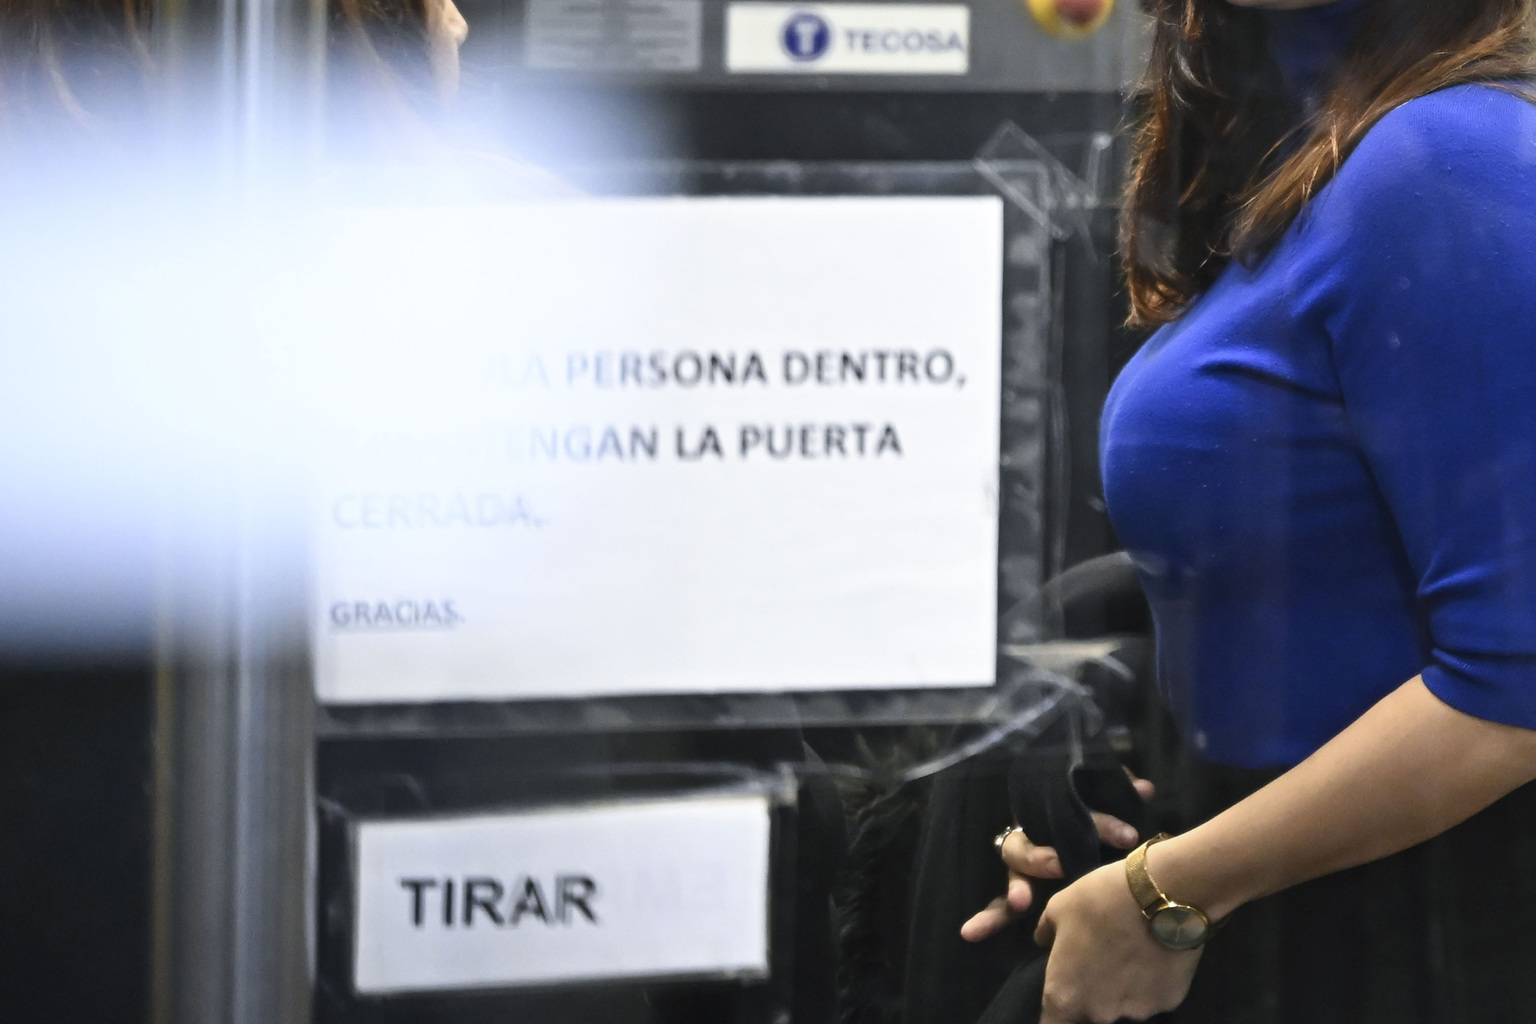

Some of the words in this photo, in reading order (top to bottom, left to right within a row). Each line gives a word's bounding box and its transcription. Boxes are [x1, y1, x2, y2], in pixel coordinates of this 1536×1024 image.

[846, 29, 965, 53] TECOSA
[564, 349, 768, 389] PERSONA
[782, 348, 968, 389] DENTRO,
[675, 423, 724, 460] LA
[739, 421, 904, 459] PUERTA
[329, 598, 465, 631] GRACIAS.
[400, 874, 602, 929] TIRAR
